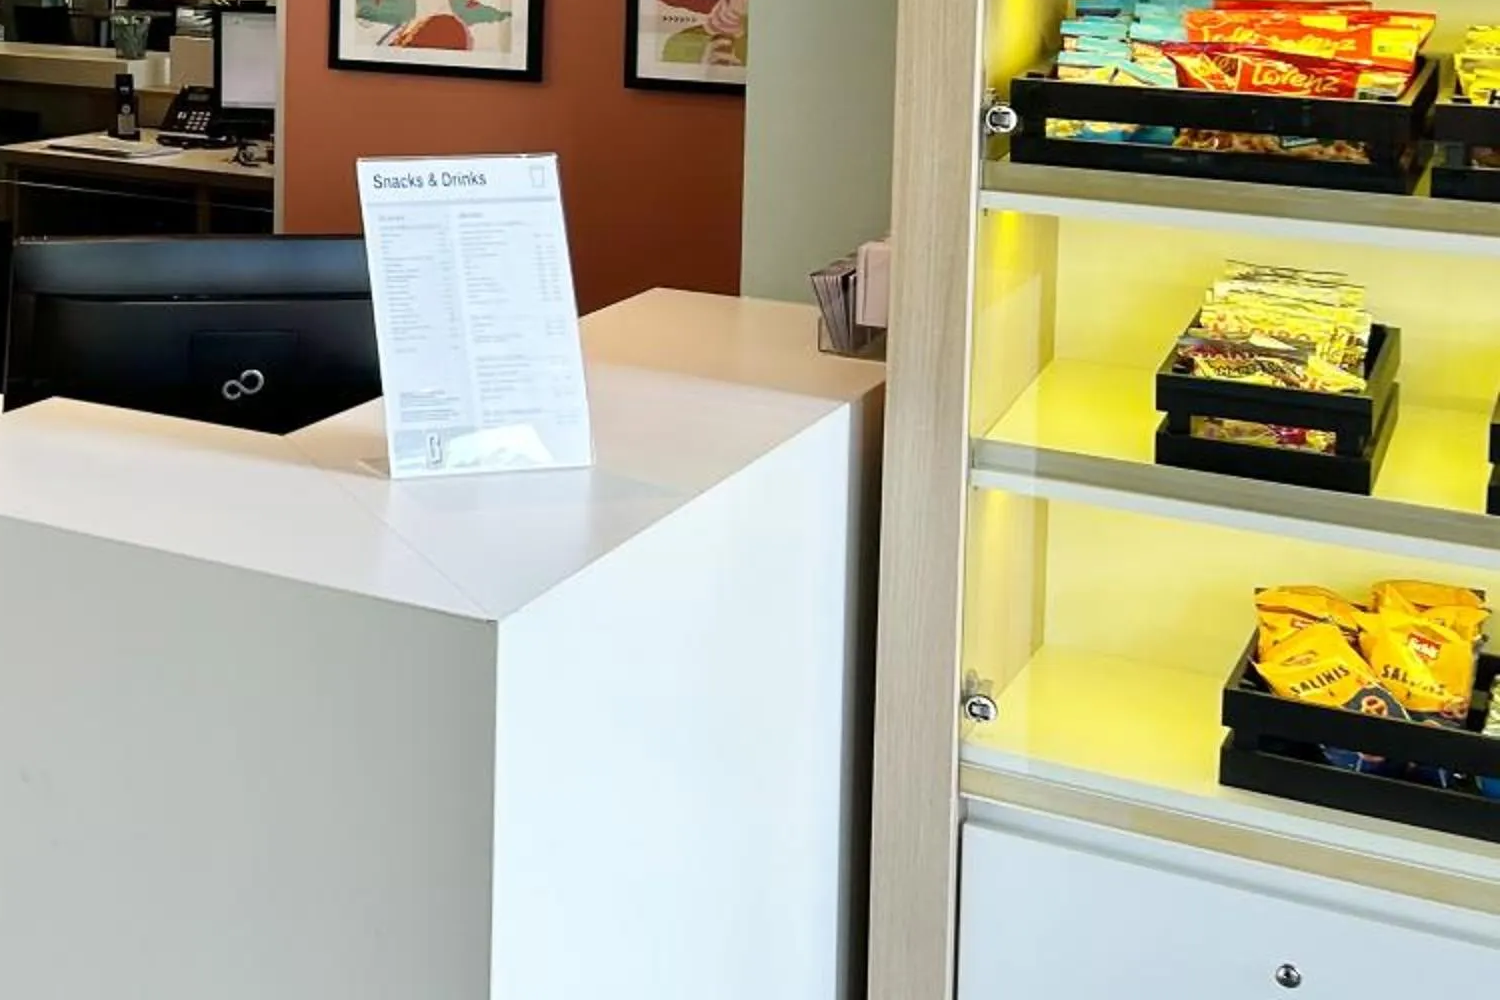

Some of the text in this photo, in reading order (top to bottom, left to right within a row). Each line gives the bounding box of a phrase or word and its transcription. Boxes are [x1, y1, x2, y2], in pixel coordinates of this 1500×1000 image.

[1251, 63, 1340, 93] Lorenz
[373, 171, 488, 189] Snacks & Drinks
